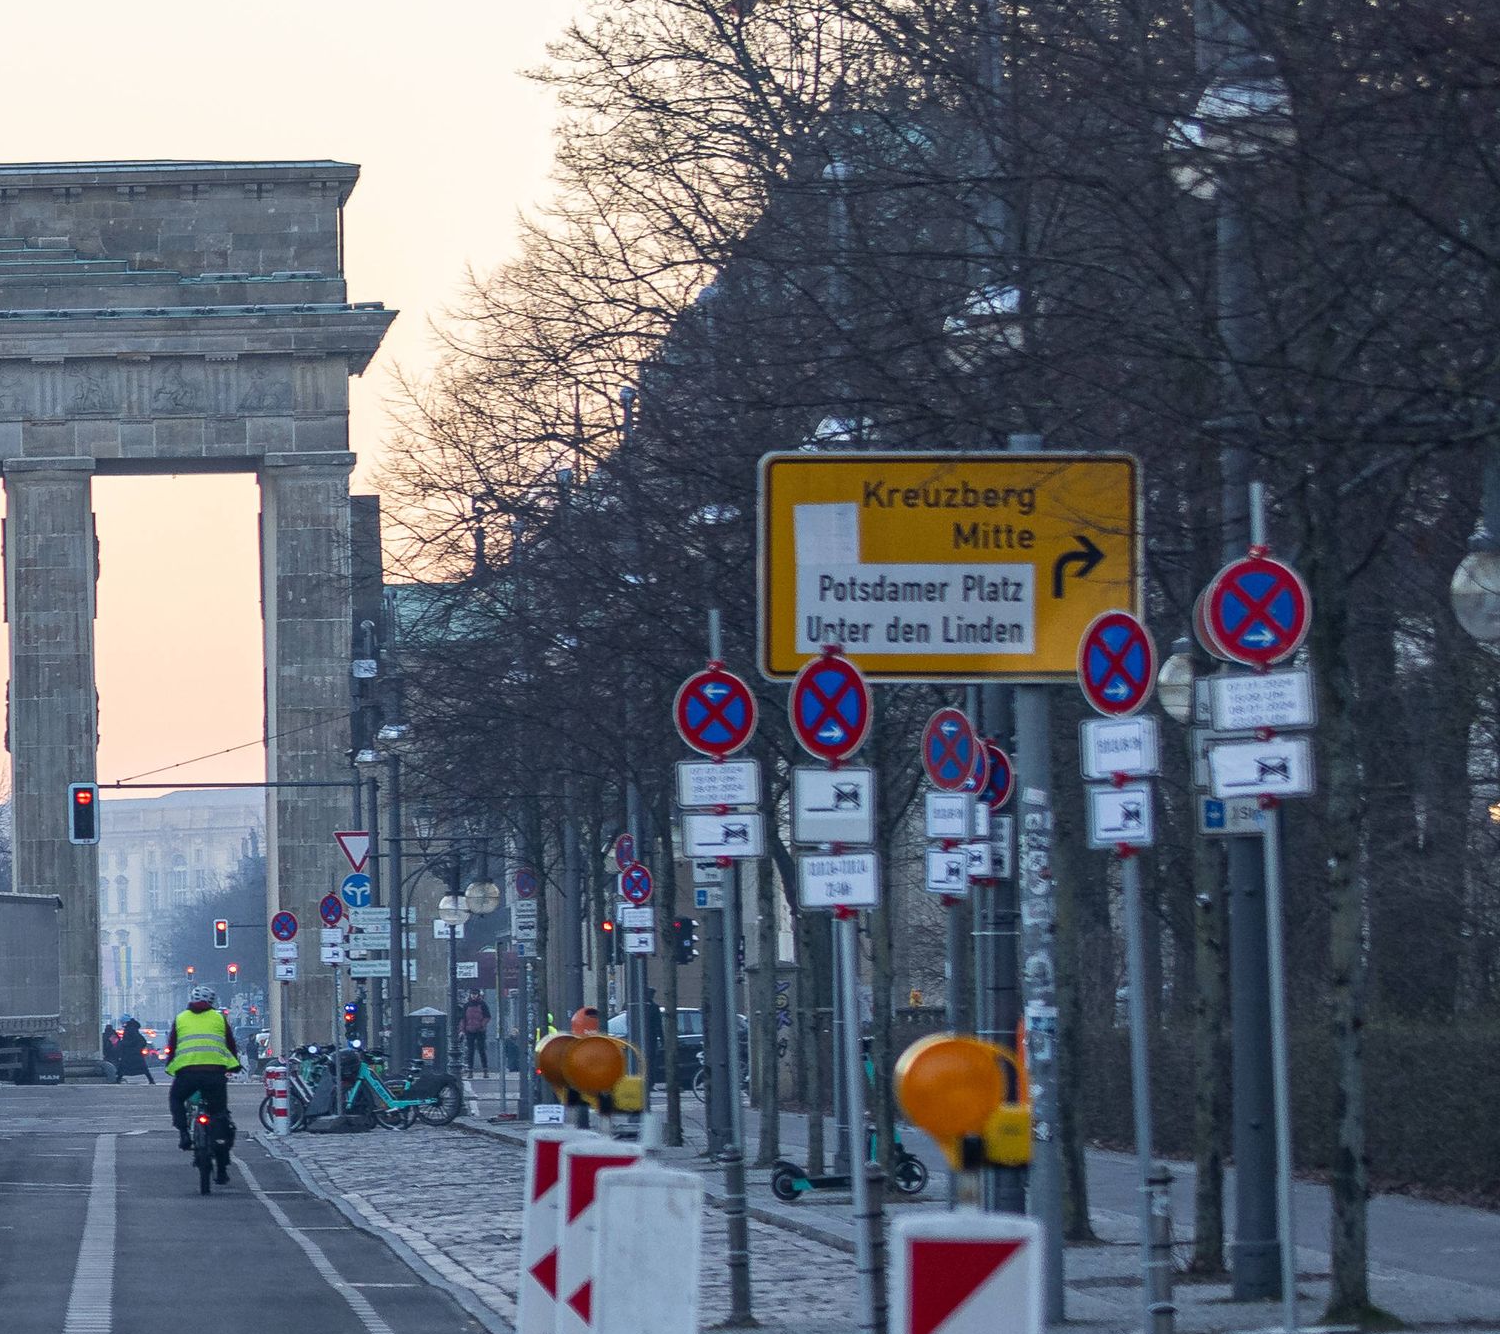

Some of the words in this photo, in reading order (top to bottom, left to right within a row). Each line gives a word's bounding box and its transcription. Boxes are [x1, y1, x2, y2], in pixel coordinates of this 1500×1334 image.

[863, 481, 1036, 514] Kreuzberg
[953, 522, 1036, 550] Mitte
[819, 574, 949, 602] Potsdamer
[962, 574, 1023, 602] Platz
[806, 616, 873, 644] Unter
[886, 616, 930, 643] den
[942, 616, 1023, 643] Linden
